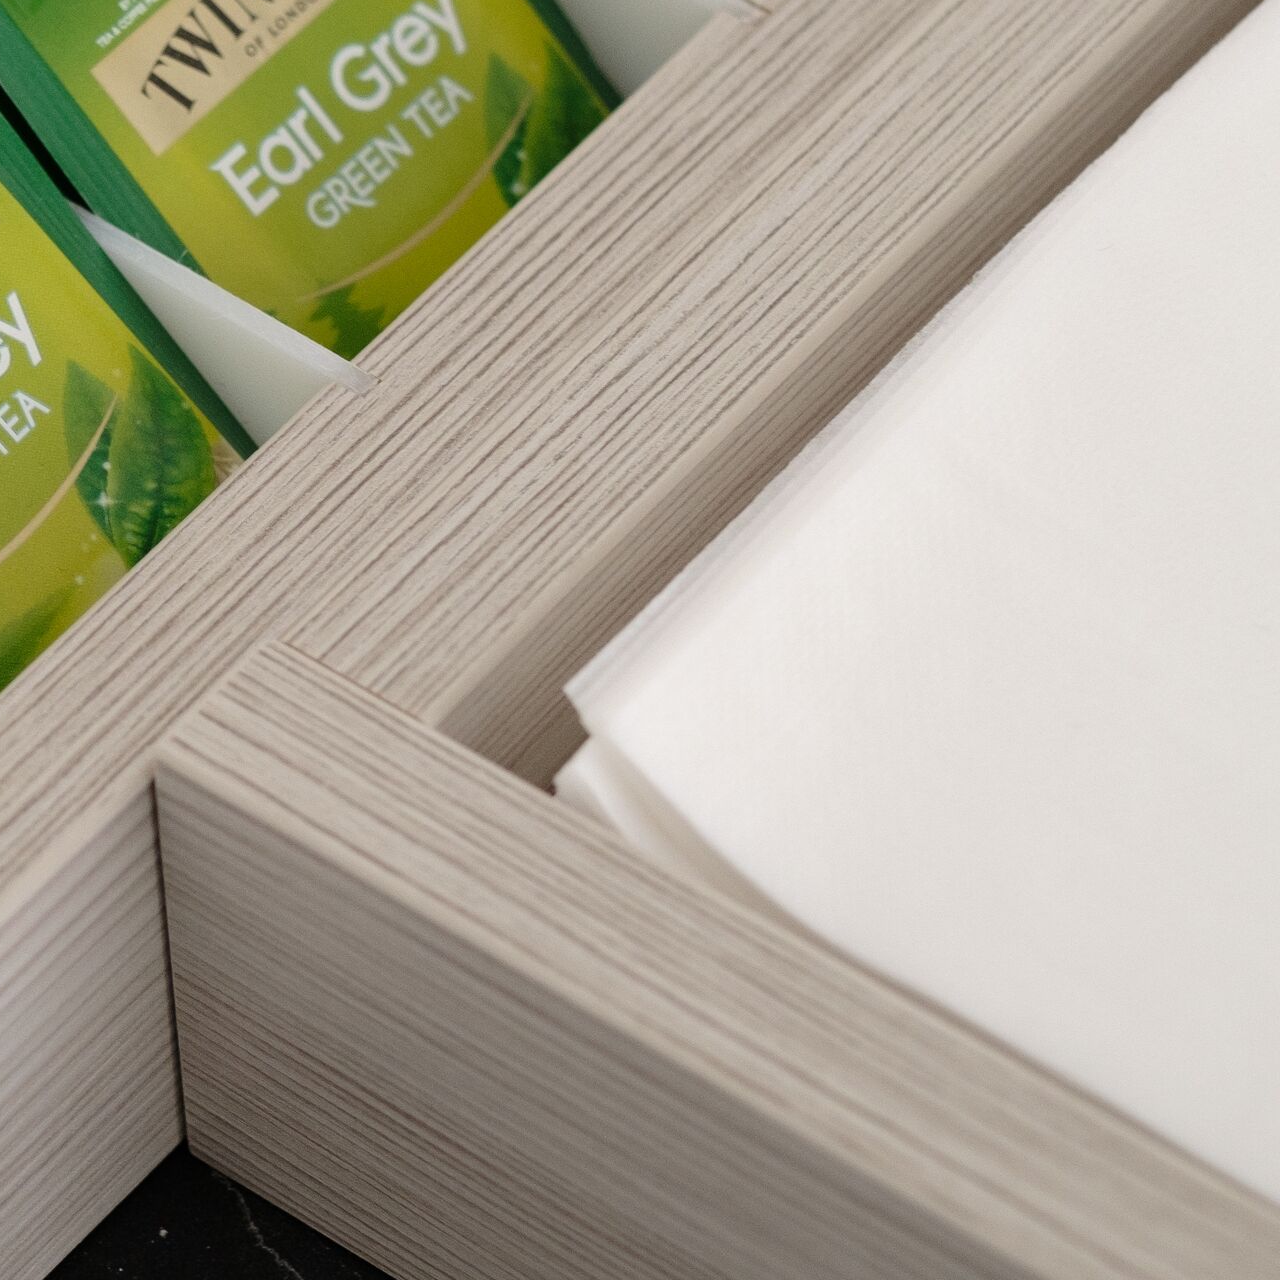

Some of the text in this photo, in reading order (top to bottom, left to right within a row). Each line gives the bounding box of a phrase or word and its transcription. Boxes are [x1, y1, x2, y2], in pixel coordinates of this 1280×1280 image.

[244, 35, 266, 58] OF
[210, 83, 344, 218] Earl
[306, 74, 475, 230] GREEN TEA
